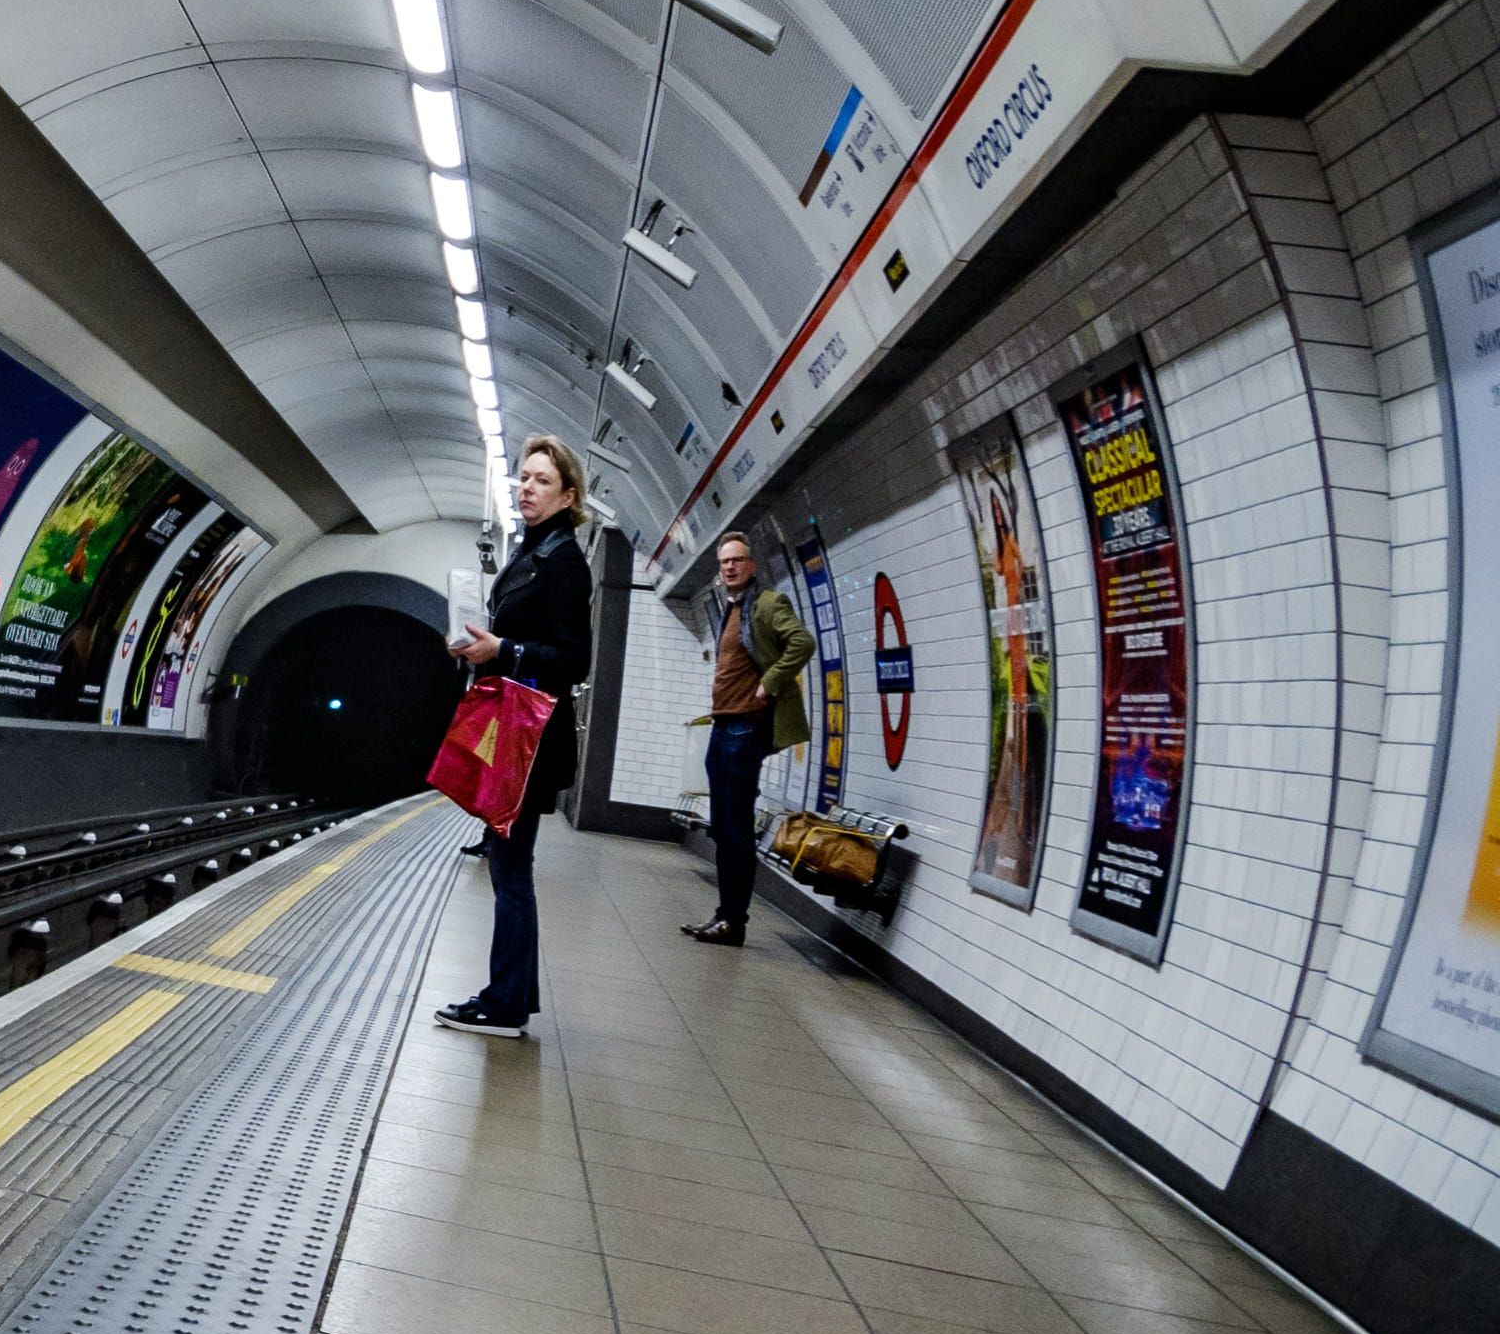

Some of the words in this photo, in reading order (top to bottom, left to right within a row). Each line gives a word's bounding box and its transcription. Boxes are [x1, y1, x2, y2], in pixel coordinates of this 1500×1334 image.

[966, 119, 1012, 189] OXFORD
[1004, 64, 1052, 140] CIRCUS
[1085, 428, 1156, 484] CLASSICAL
[1093, 469, 1163, 517] SPECTACULAR
